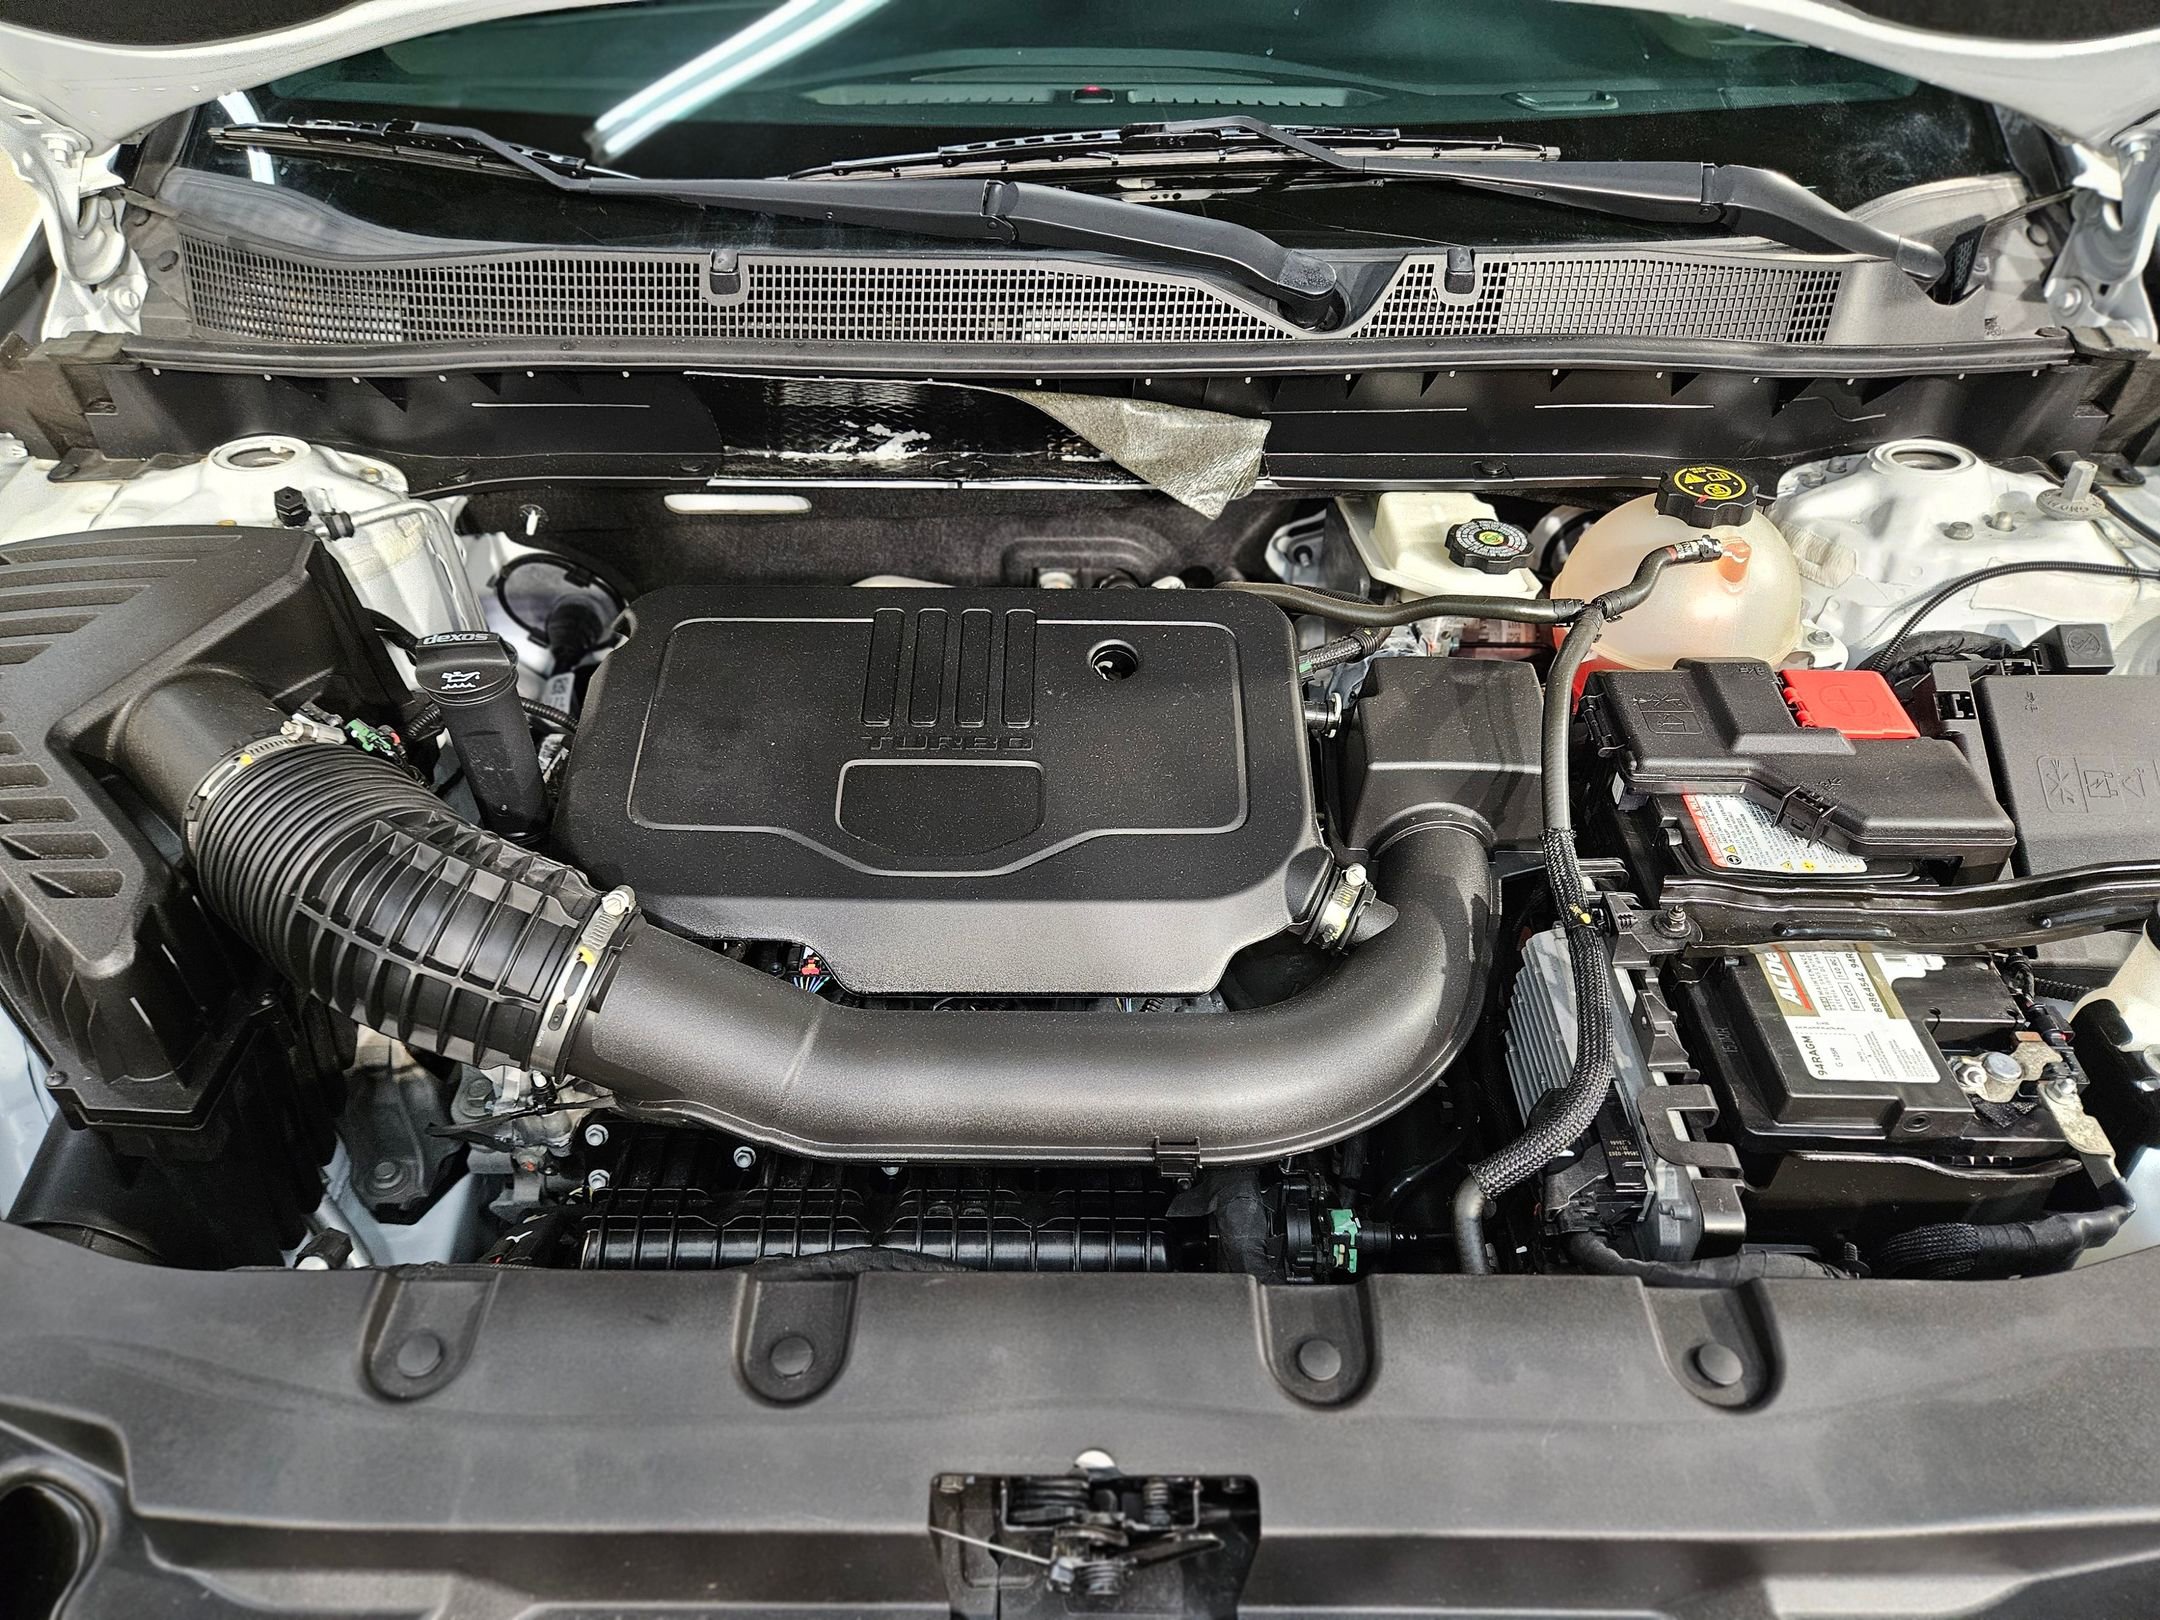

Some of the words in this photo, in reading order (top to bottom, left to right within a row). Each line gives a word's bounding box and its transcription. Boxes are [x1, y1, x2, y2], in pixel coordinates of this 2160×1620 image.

[423, 634, 489, 645] dexos
[860, 736, 1034, 750] TURBO
[1799, 954, 1824, 995] MAINTENANCE
[1854, 972, 1883, 1013] 88864542
[1801, 1035, 1828, 1077] 94RAGM
